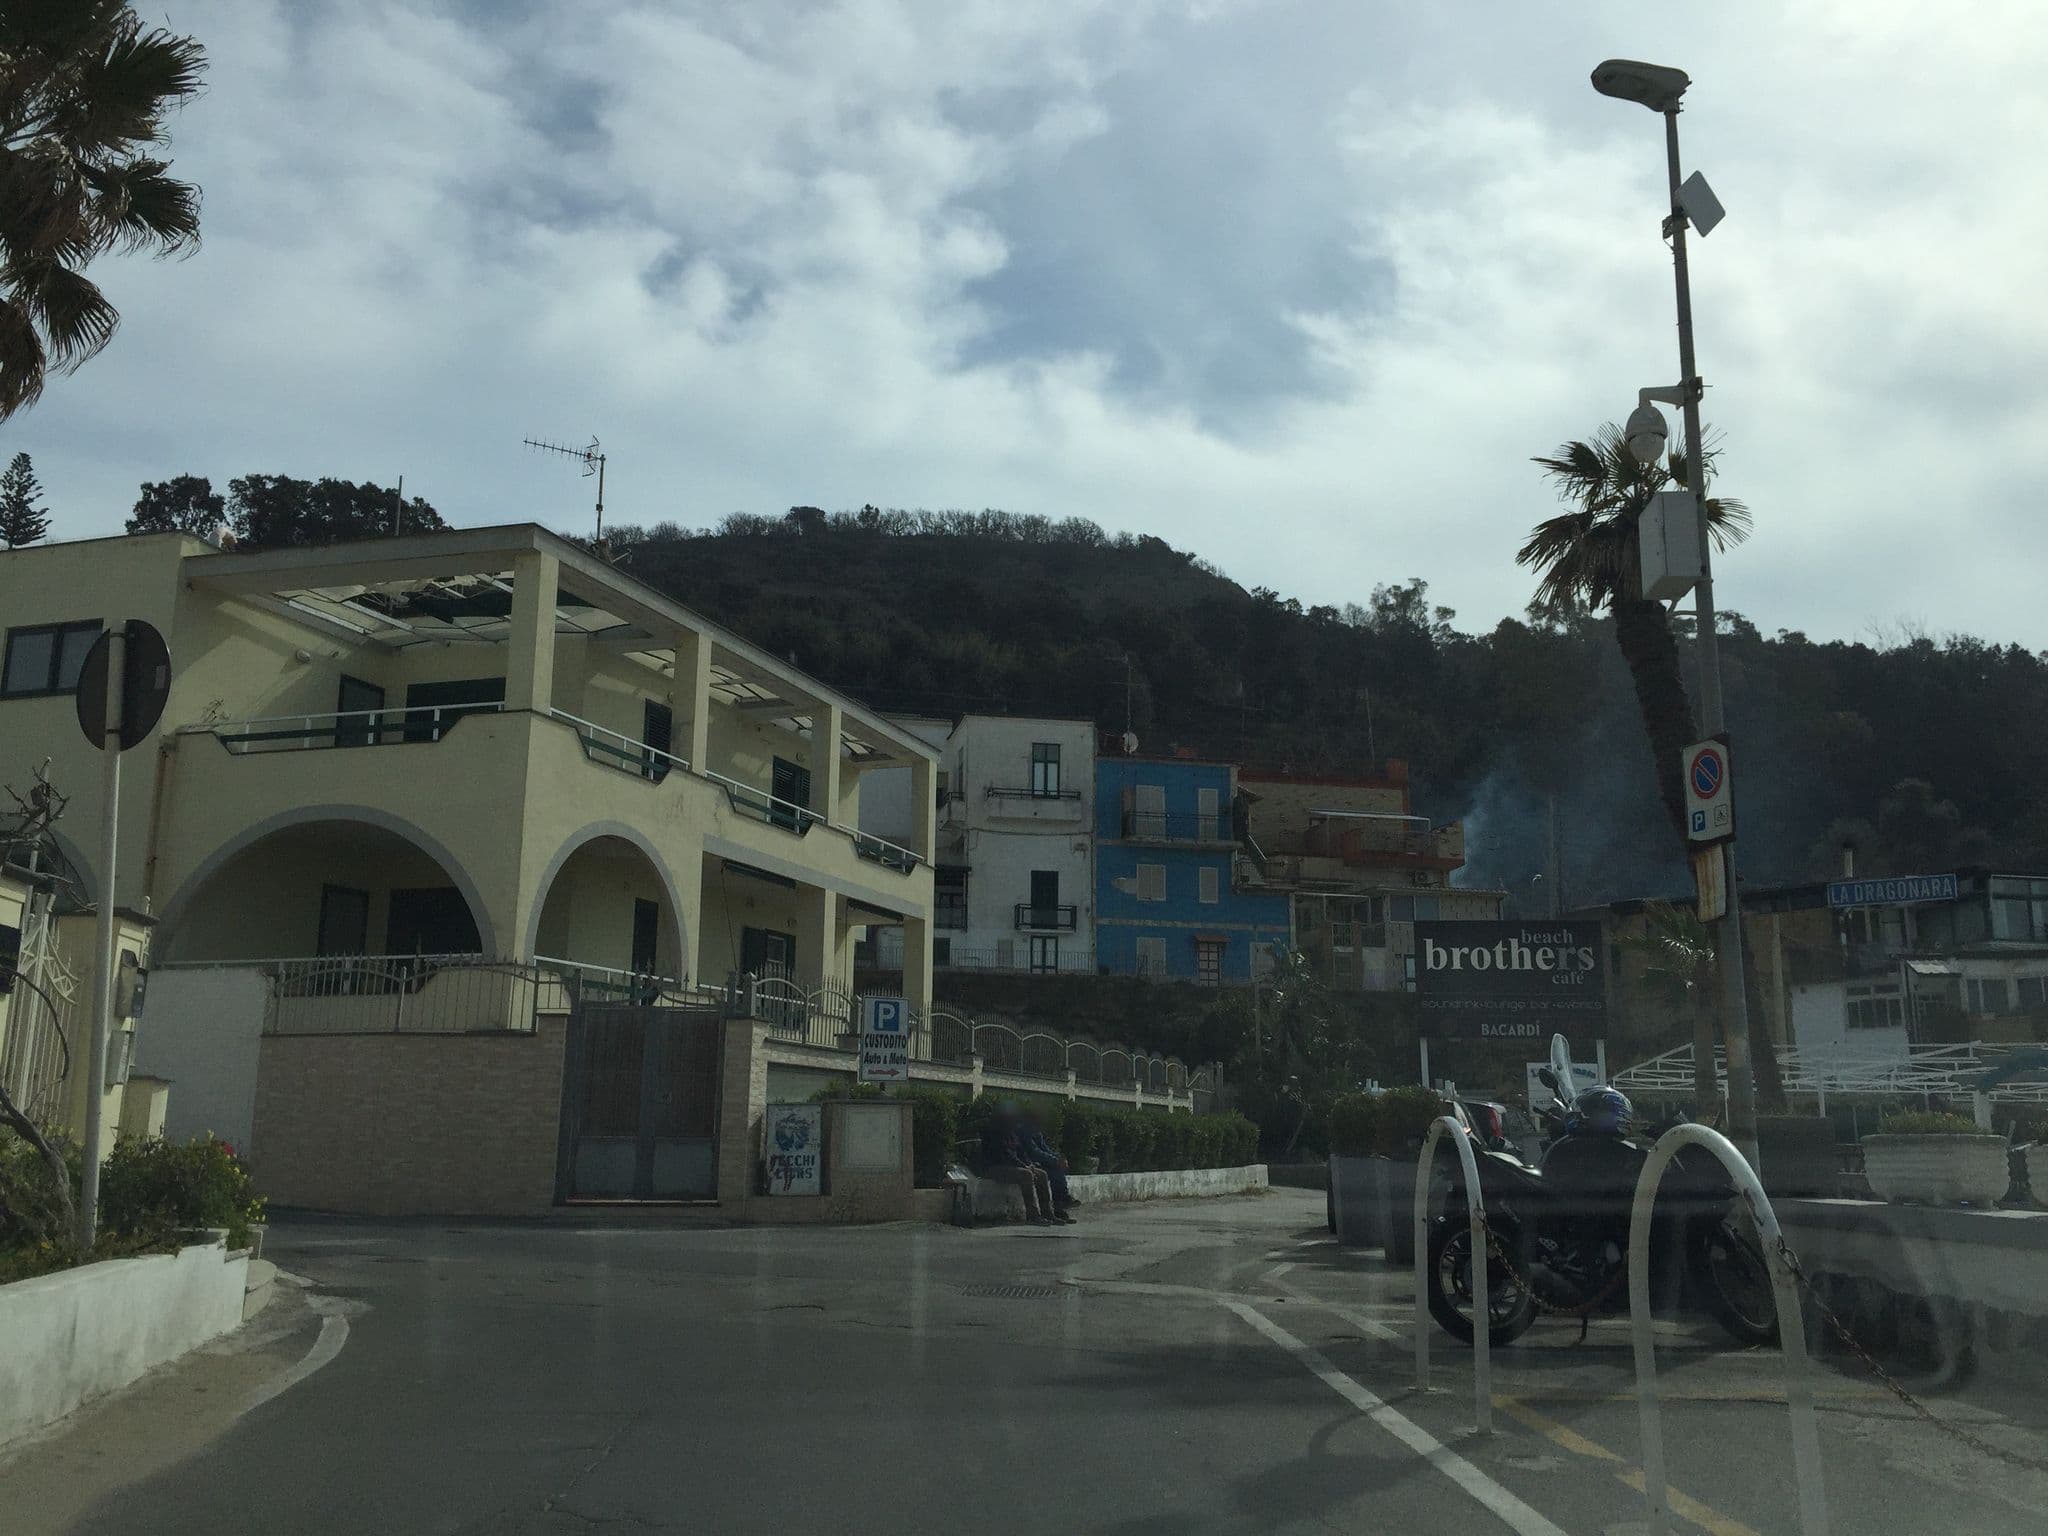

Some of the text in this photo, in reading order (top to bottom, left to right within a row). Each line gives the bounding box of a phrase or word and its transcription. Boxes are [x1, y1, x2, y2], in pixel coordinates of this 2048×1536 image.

[1831, 877, 1953, 904] LA DRAGONARA
[1521, 928, 1573, 944] beach
[1424, 937, 1596, 971] brothers
[1552, 970, 1585, 985] café
[864, 1033, 907, 1049] CUSTODITO
[864, 1052, 882, 1065] Auto
[889, 1052, 907, 1065] Moto
